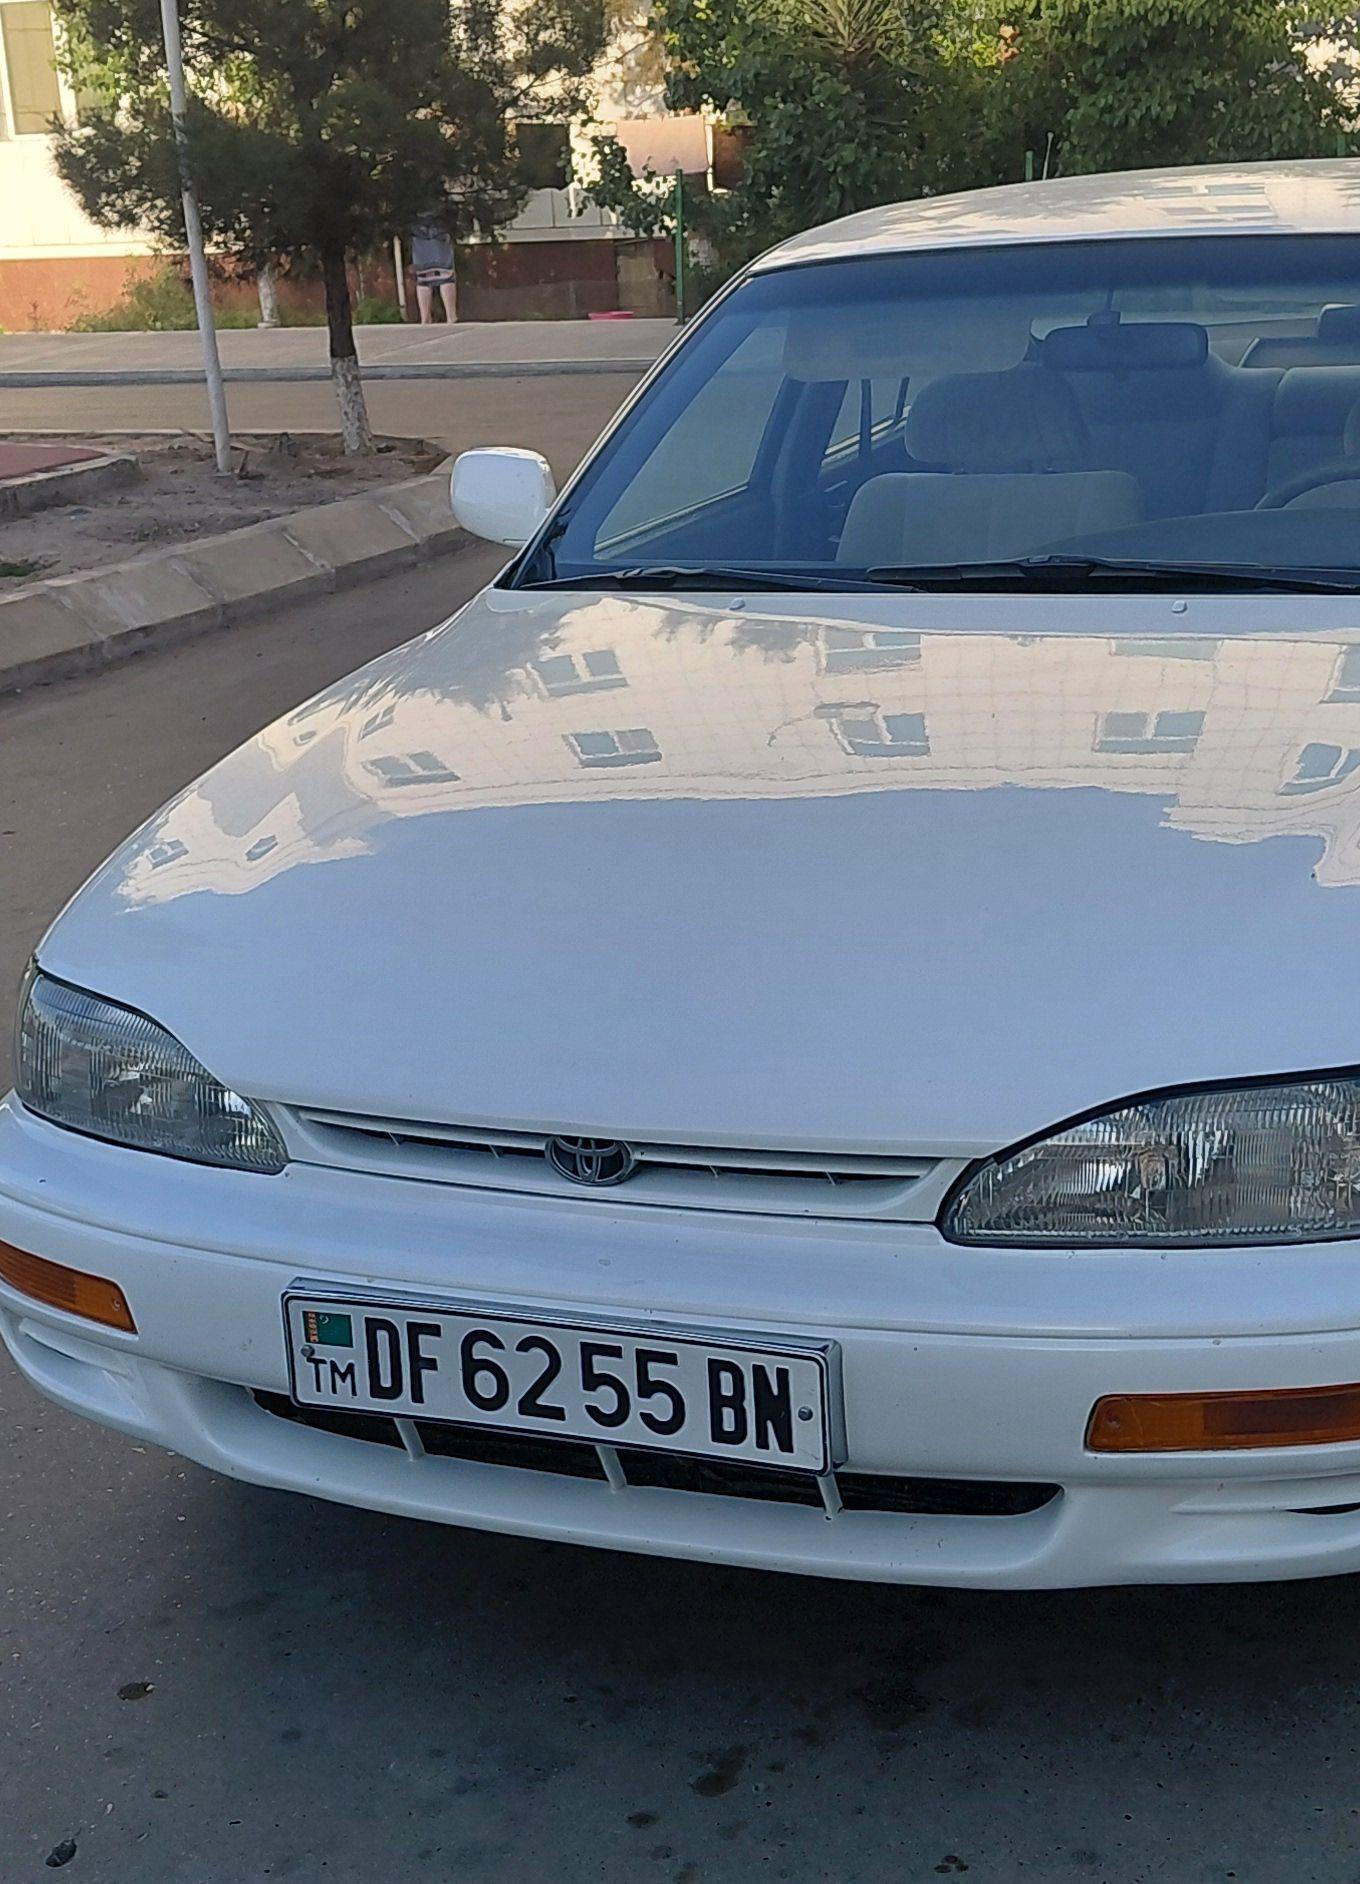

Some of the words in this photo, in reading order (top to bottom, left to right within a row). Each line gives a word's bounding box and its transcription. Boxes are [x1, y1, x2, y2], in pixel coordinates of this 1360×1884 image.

[306, 1355, 357, 1397] TM
[364, 1316, 441, 1404] DF
[460, 1329, 686, 1435] 6255
[707, 1357, 794, 1454] BN
